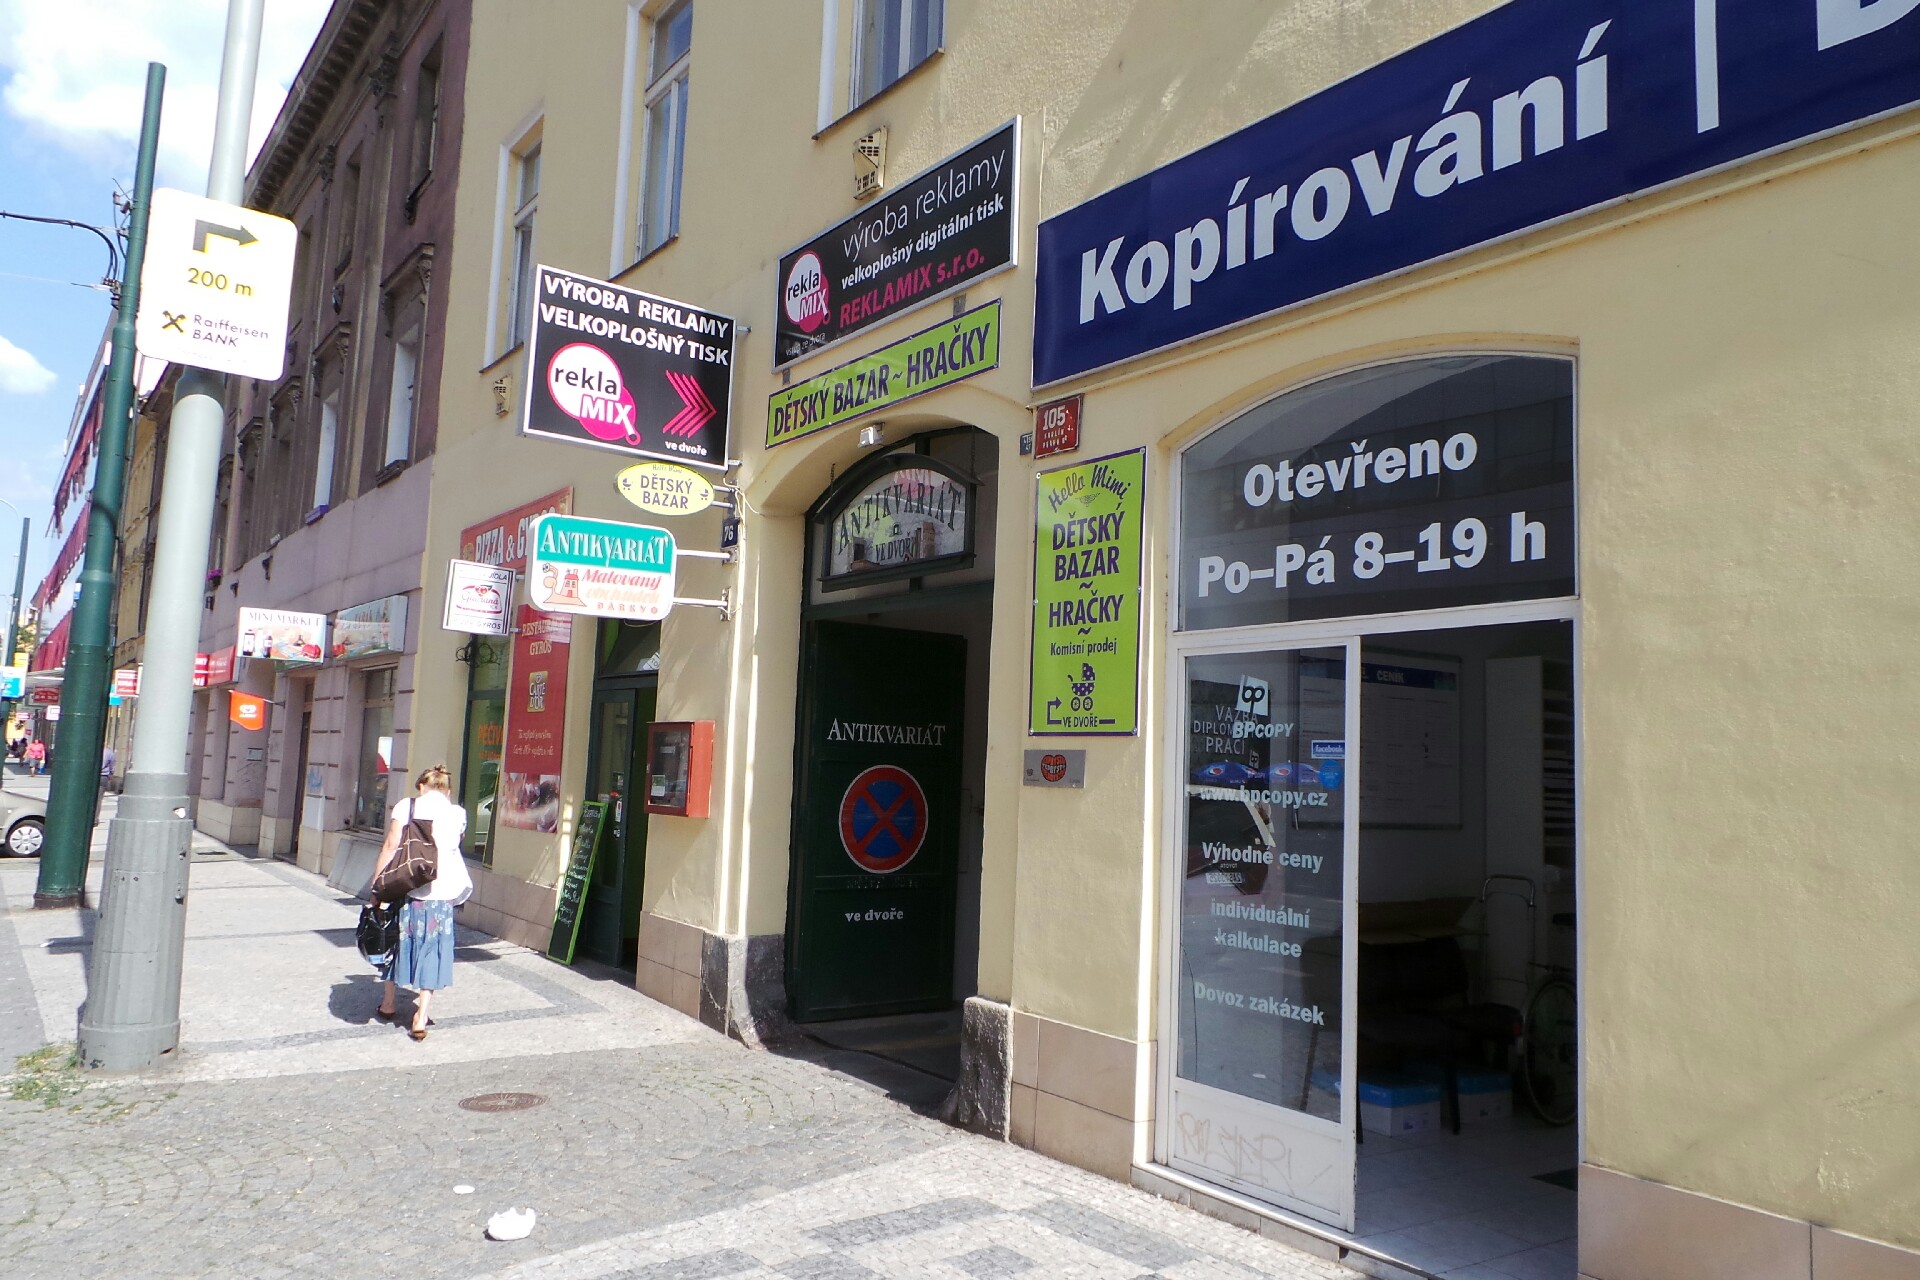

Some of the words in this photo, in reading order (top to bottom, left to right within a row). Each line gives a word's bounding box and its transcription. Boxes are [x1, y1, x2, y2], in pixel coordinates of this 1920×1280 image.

[1079, 19, 1613, 325] Kopírování
[843, 204, 908, 262] výroba
[915, 150, 1005, 220] reklamy
[841, 238, 914, 289] velkoplošný
[915, 208, 973, 254] digitální
[976, 194, 1004, 221] tisk
[187, 267, 227, 290] 200
[235, 283, 252, 296] m
[787, 270, 820, 299] rekla
[839, 263, 933, 327] REKLAMIX
[936, 248, 985, 283] s.r.o.
[544, 274, 630, 314] VÝROBA
[638, 299, 729, 339] REKLAMY
[800, 289, 828, 321] MIX
[192, 329, 239, 347] BANK
[194, 314, 269, 339] Raiffeisen
[540, 302, 685, 356] VELKOPLOŠNÝ
[687, 340, 729, 366] TISK
[554, 366, 618, 396] rekla
[774, 378, 829, 437] DĚTSKÝ
[833, 364, 890, 416] BAZAR
[907, 323, 990, 388] HRAČKY
[580, 394, 634, 428] MIX
[1043, 405, 1066, 430] 105
[665, 441, 677, 450] ve
[678, 442, 708, 457] dvoře
[641, 473, 693, 495] DĚTSKÝ
[1243, 432, 1477, 507] Otevřeno
[643, 491, 689, 509] BAZAR
[1048, 472, 1086, 513] Hello
[1091, 464, 1131, 500] Mimi
[724, 525, 734, 542] 76
[838, 481, 961, 555] ANTIKVARIÁT
[1053, 502, 1125, 550] DĚTSKÝ
[475, 526, 504, 566] PIZZA
[506, 535, 515, 564] &
[540, 523, 669, 567] ANTIKVARIÁT
[1510, 510, 1546, 563] h
[875, 543, 886, 562] VE
[1055, 546, 1120, 582] BAZAR
[1048, 589, 1125, 628] HRAČKY
[530, 640, 552, 656] GYROS
[1050, 640, 1086, 657] Komisní
[1087, 638, 1117, 658] prodej
[827, 718, 946, 746] ANTIKVARIÁT
[1062, 716, 1072, 728] VE
[1073, 713, 1098, 728] DVOŘE
[1232, 721, 1295, 739] BPCOPY
[1314, 744, 1343, 753] facebook
[1199, 786, 1328, 809] www.bpcopy.cz
[1202, 841, 1274, 864] Výhodné
[1279, 852, 1324, 874] ceny
[845, 911, 861, 922] ve
[864, 908, 904, 921] dvoře
[1216, 928, 1302, 958] kalkulace
[1194, 981, 1244, 1008] Dovoz
[1249, 996, 1325, 1026] zakázek
